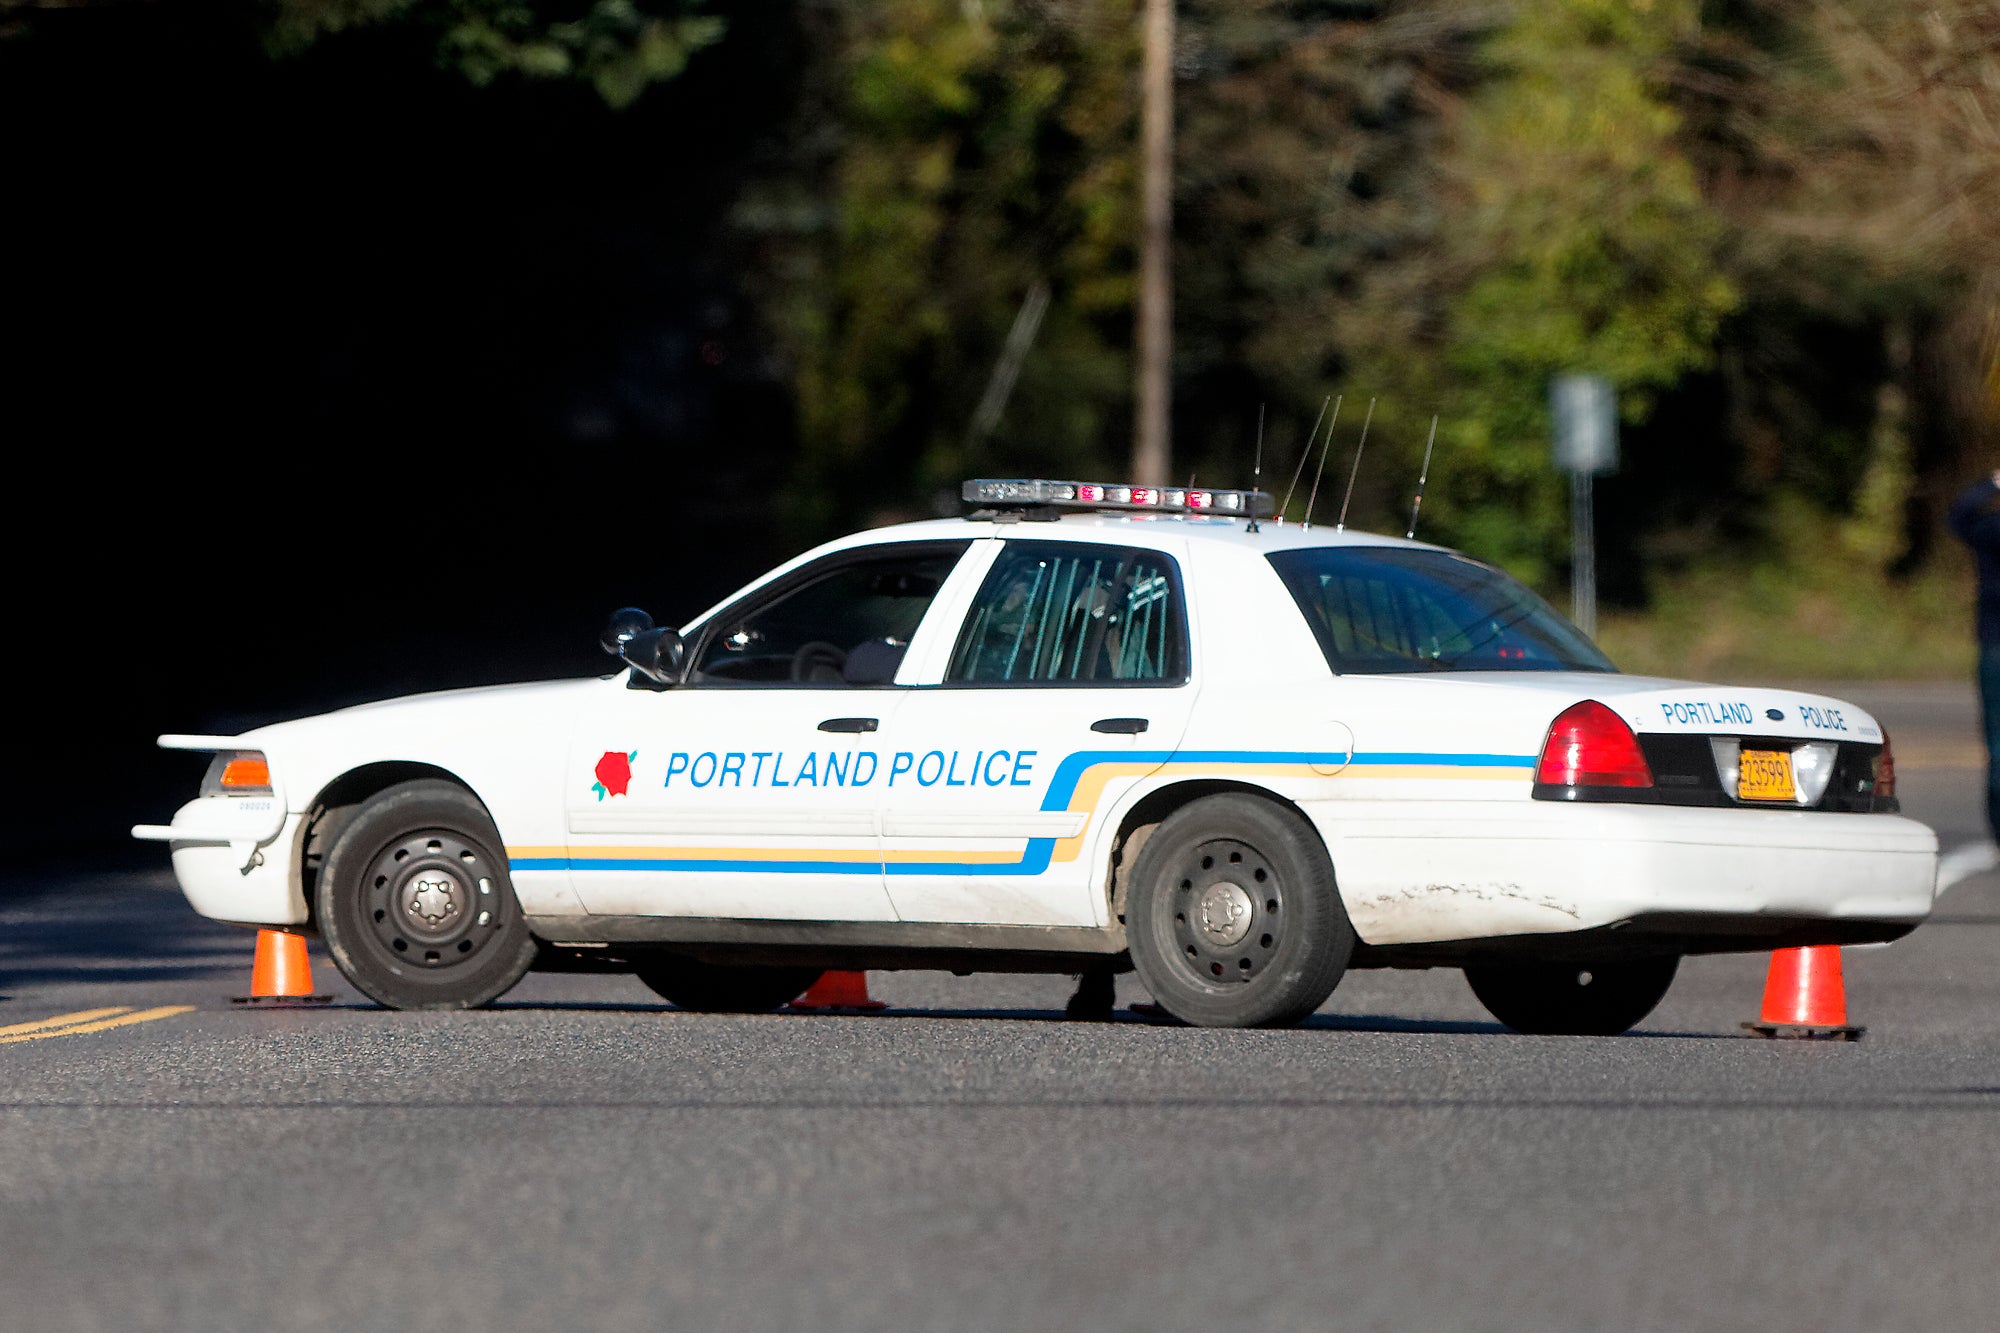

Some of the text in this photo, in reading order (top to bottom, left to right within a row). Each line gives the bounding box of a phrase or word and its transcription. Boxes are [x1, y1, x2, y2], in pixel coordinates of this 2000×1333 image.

[1660, 702, 1753, 725] PORTLAND
[1799, 705, 1848, 732] POLICE
[664, 749, 1039, 789] PORTLAND POLICE
